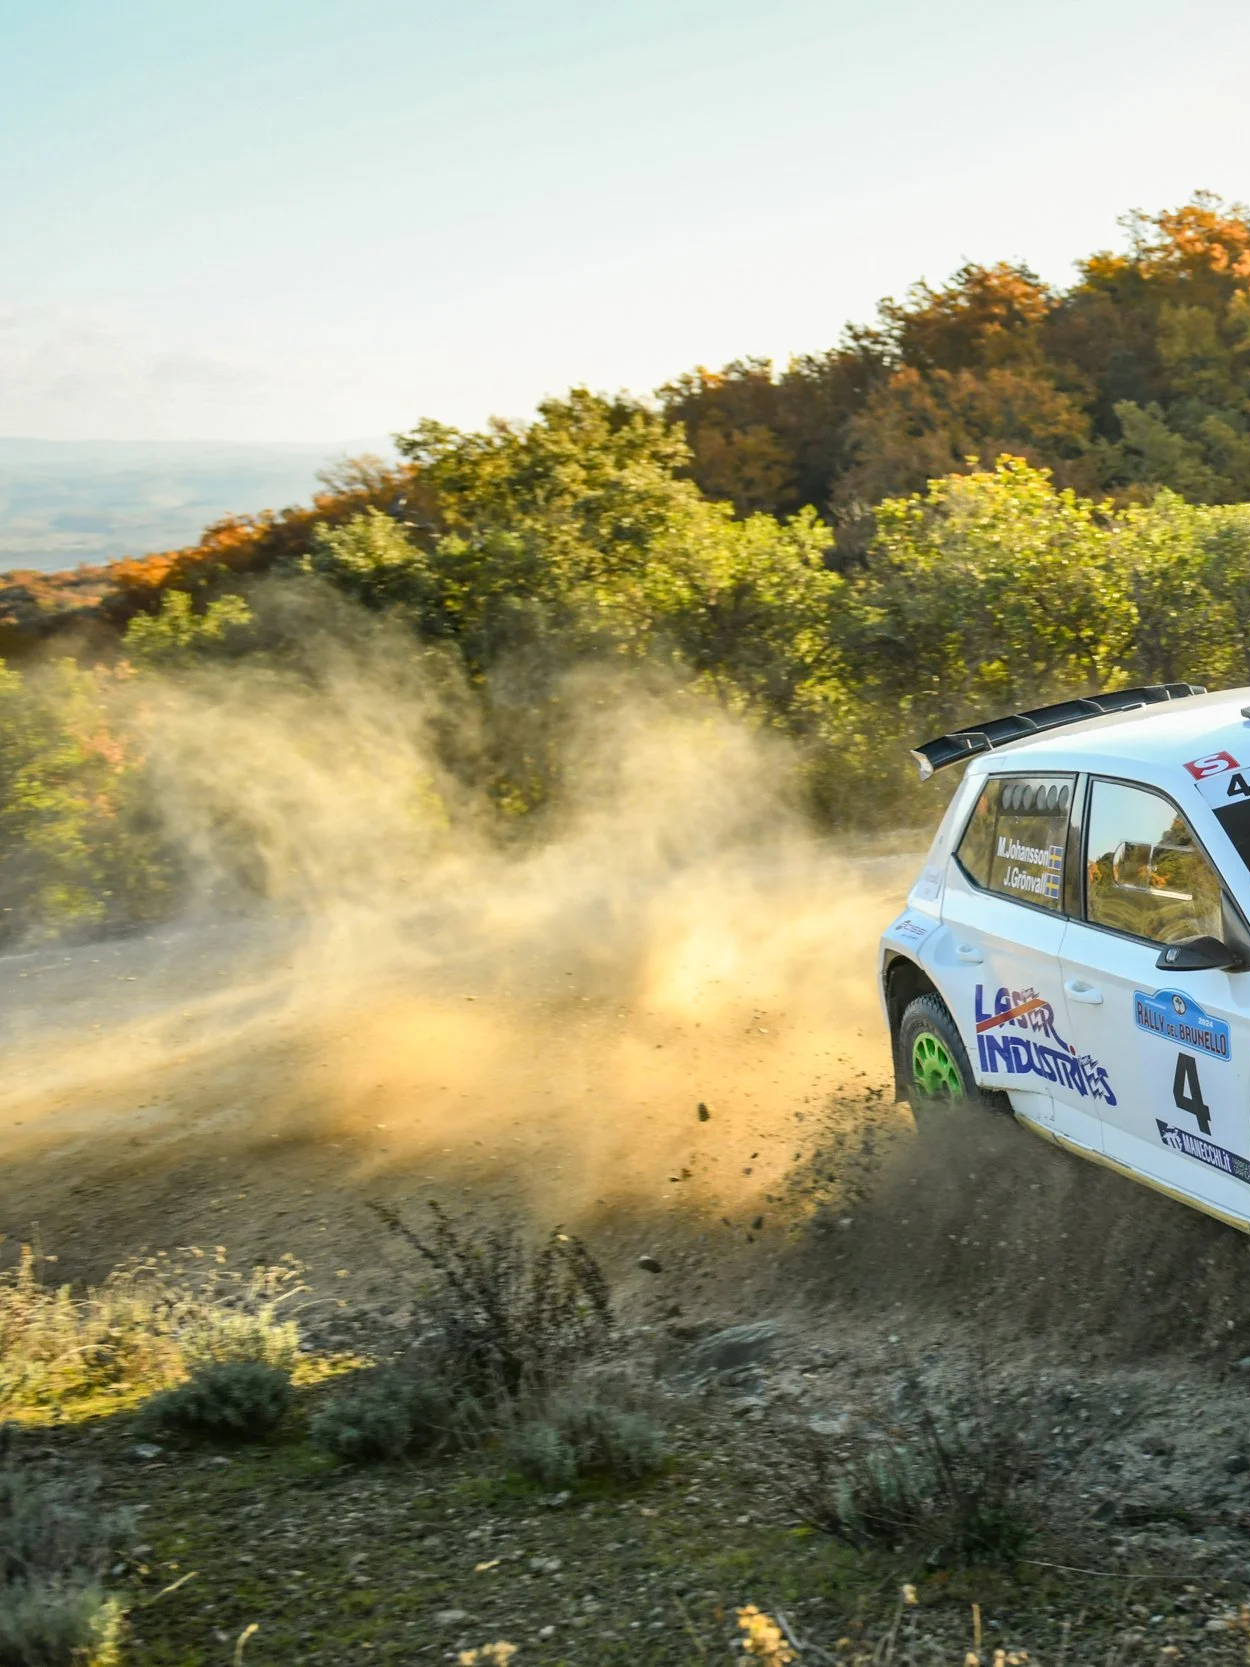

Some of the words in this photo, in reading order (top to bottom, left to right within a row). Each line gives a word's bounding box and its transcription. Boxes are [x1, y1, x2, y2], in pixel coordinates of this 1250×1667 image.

[997, 836, 1049, 866] M.Johansson
[976, 984, 1070, 1053] LASER
[1137, 1001, 1164, 1032] RALLY
[1179, 1024, 1227, 1055] BRUNELLO
[977, 1034, 1117, 1106] INDUSTRIES
[1173, 1052, 1211, 1136] 4
